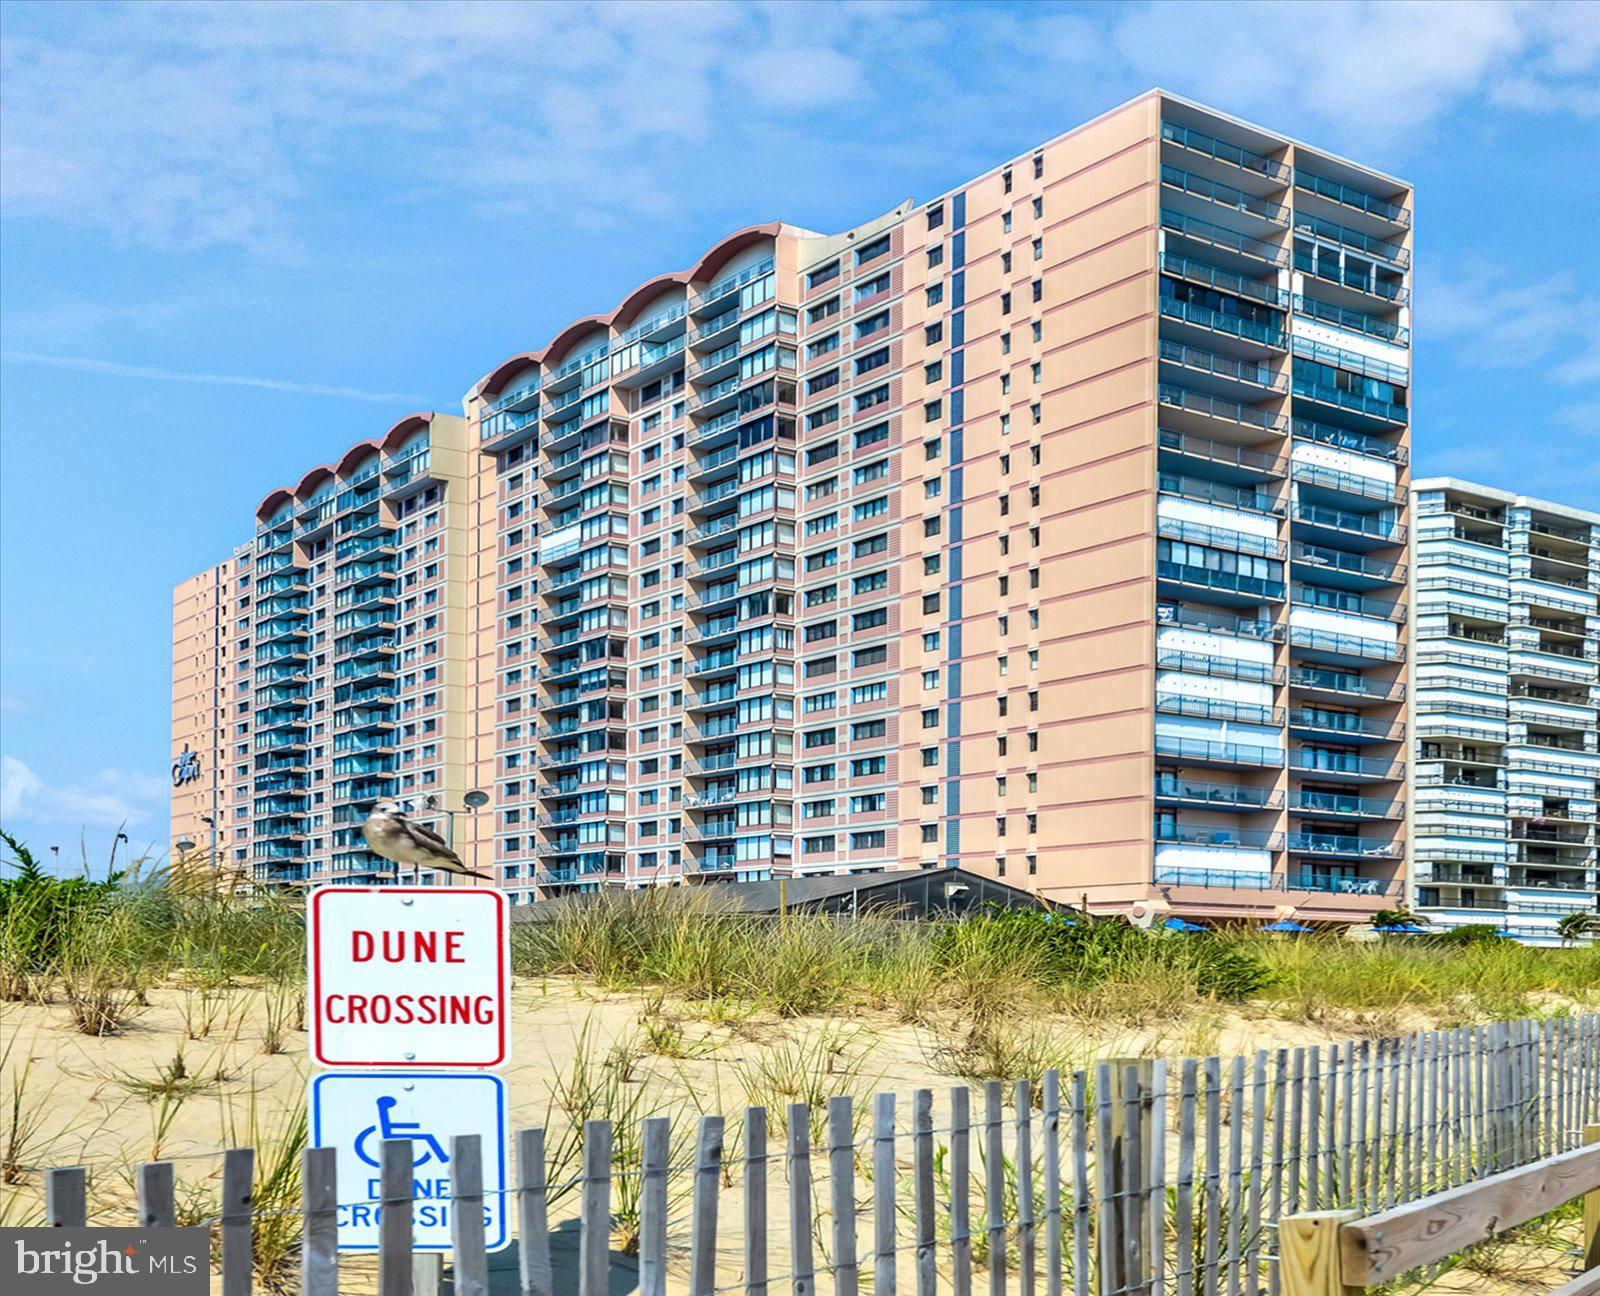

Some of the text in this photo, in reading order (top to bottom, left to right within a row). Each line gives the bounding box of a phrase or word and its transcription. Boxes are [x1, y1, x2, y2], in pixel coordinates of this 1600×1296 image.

[352, 930, 465, 963] DUNE
[325, 994, 494, 1025] CROSSING
[367, 1178, 451, 1200] DNE
